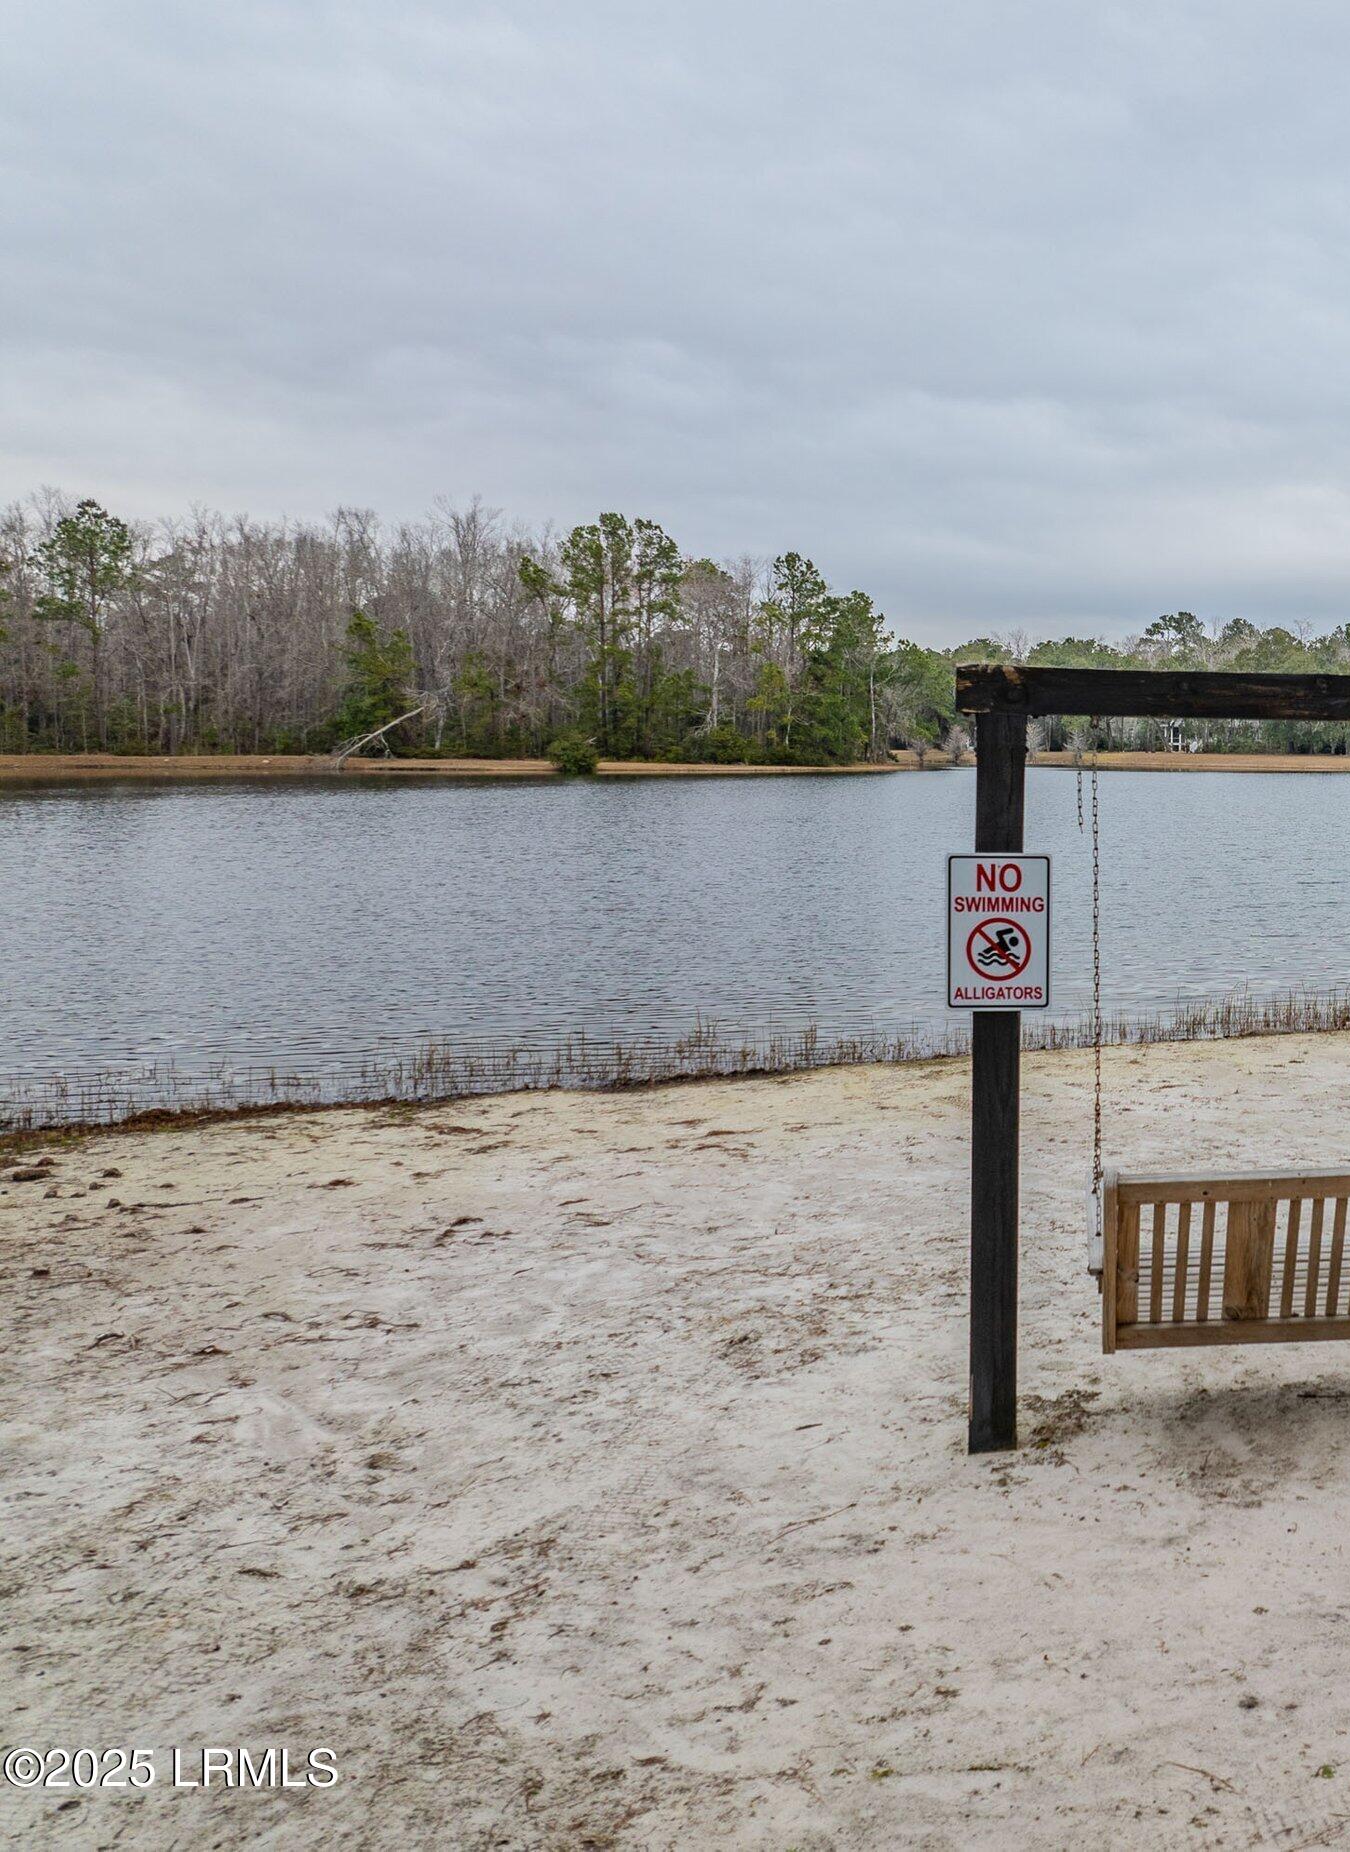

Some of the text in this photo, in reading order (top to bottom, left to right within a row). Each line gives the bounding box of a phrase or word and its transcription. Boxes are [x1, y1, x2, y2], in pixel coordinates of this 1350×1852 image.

[976, 863, 1022, 892] NO
[954, 897, 1044, 912] SWIMMING
[954, 987, 1043, 1000] ALLIGATORS
